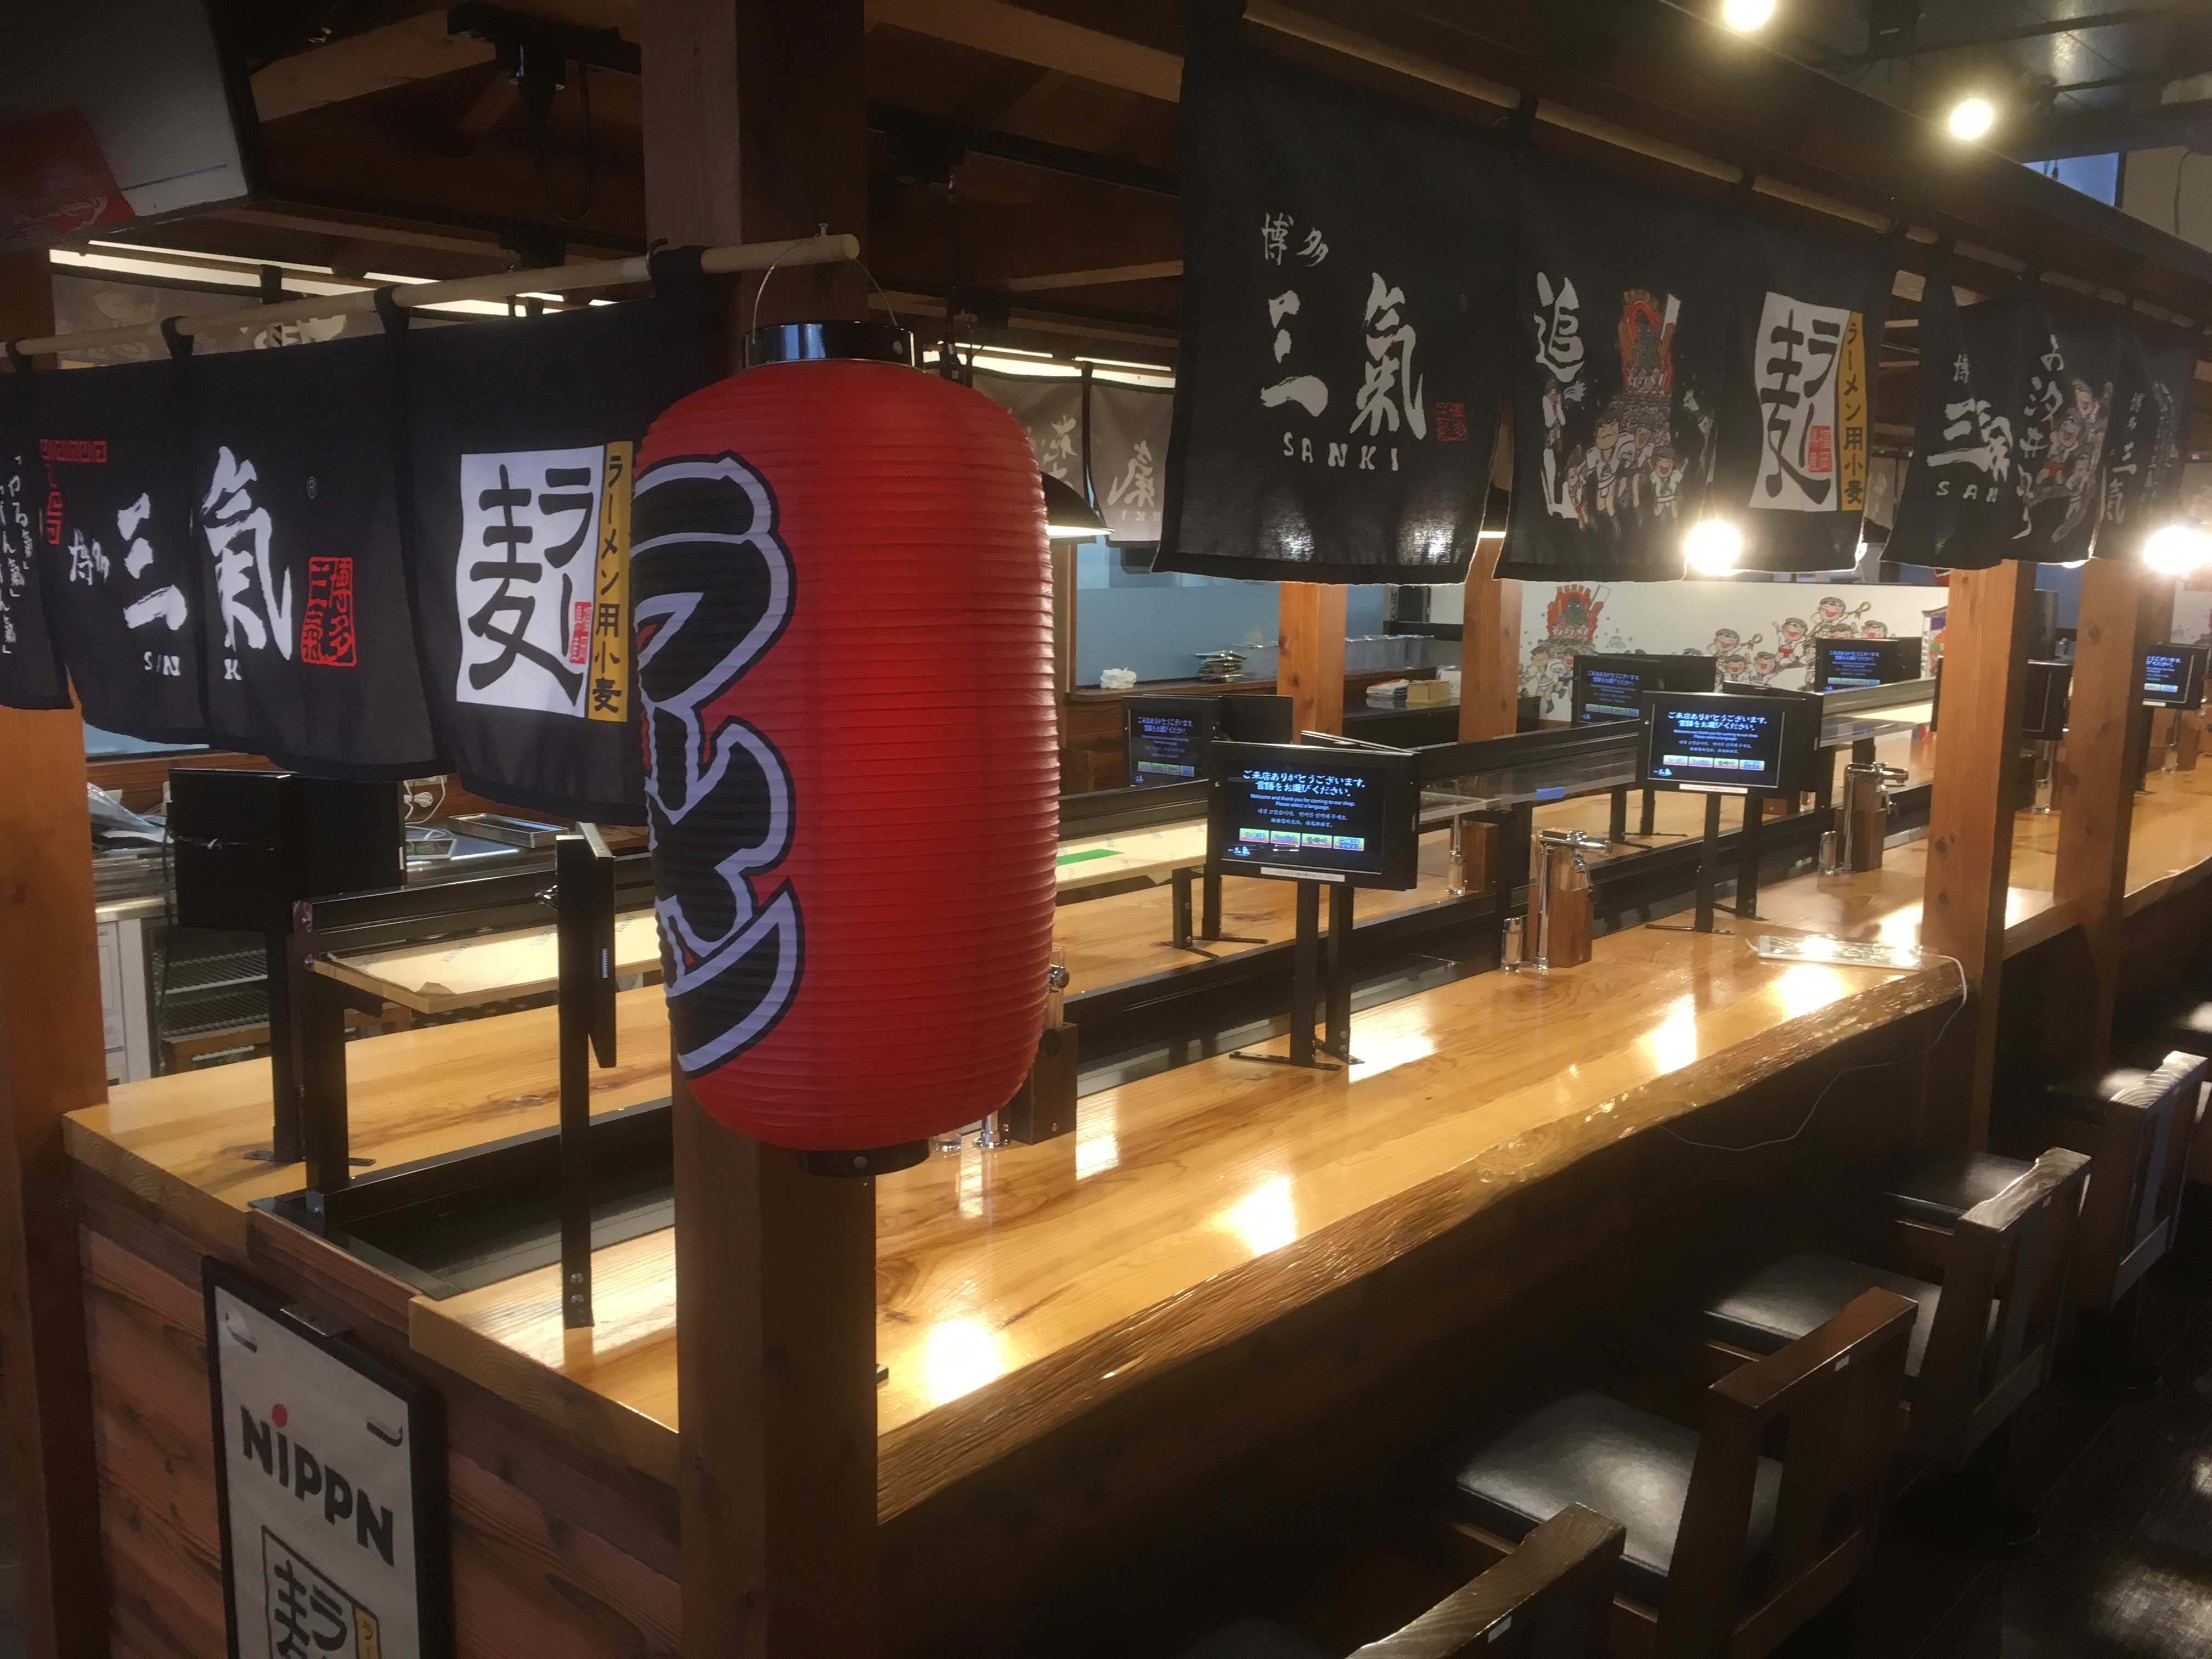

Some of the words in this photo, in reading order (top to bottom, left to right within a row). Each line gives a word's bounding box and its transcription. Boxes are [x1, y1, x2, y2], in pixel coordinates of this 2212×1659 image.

[1261, 211, 1329, 267] 博多
[1844, 321, 1863, 505] ラーメン用小麦
[1282, 431, 1398, 471] SANKI
[592, 454, 622, 713] ラーメン用小麦
[1668, 712, 1767, 724] ご来店ありがとうございます。
[1243, 770, 1365, 788] ご来店ありがとうございます。
[1255, 781, 1351, 797] 言語をお選びください。
